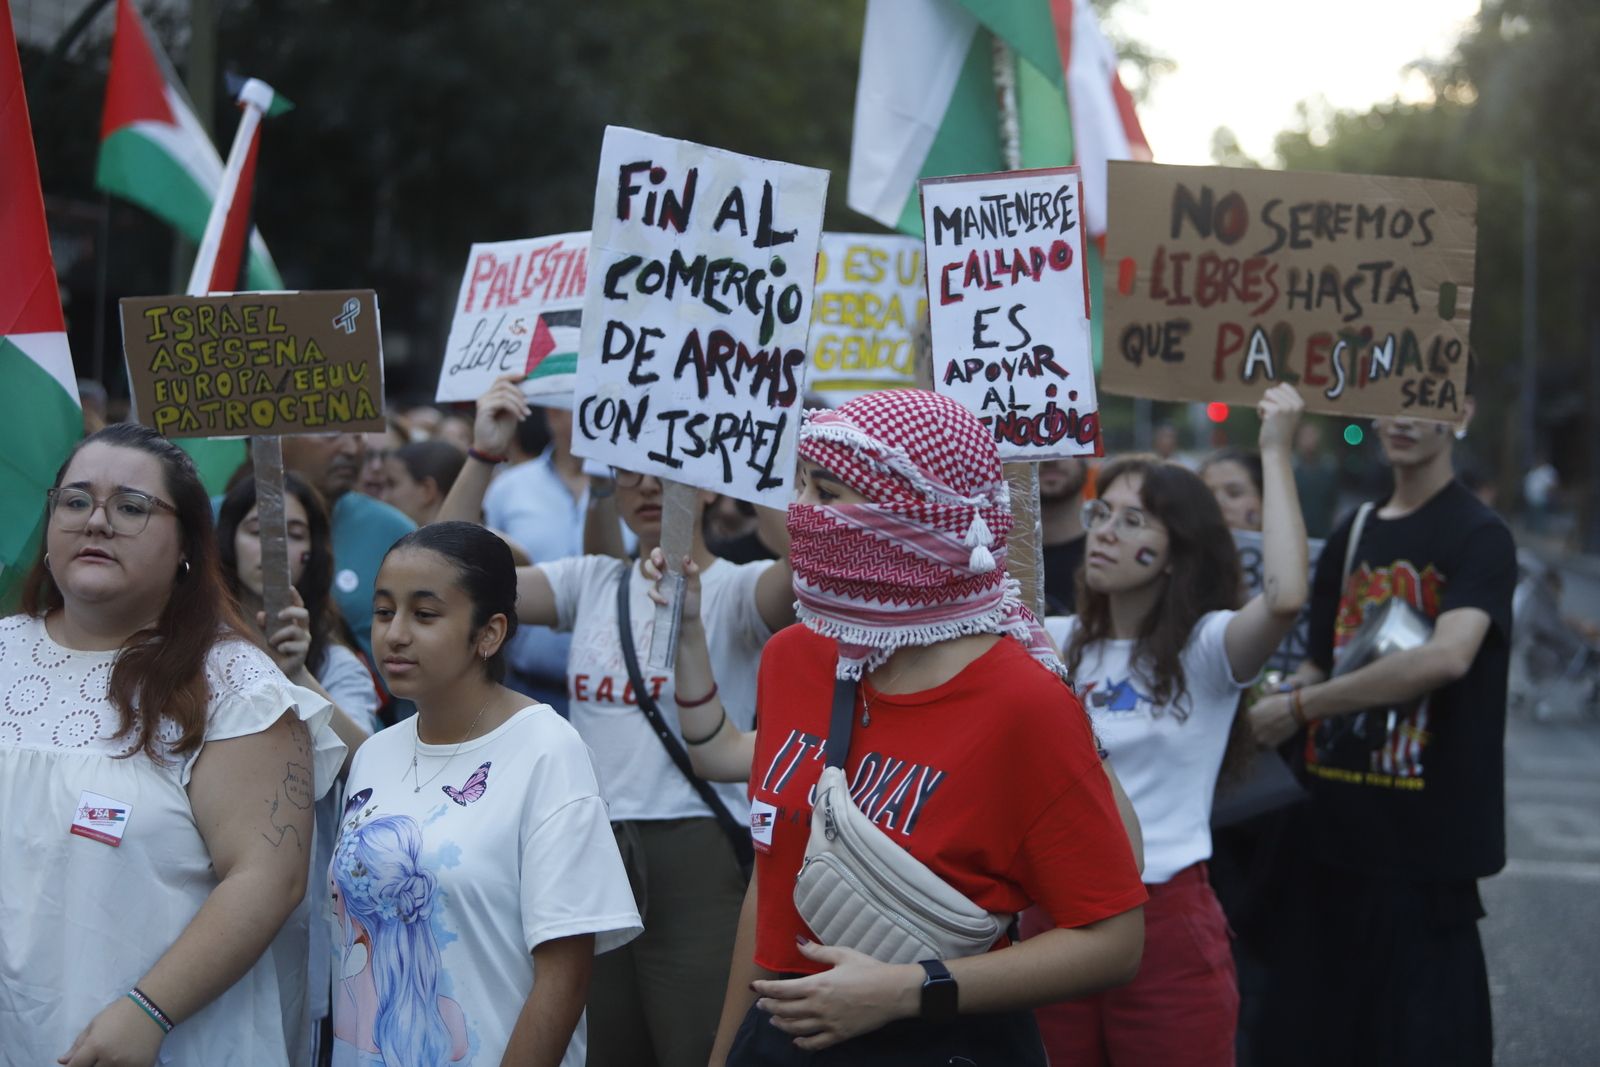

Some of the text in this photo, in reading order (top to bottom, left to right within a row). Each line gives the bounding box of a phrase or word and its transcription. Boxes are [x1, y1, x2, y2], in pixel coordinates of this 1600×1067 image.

[713, 179, 798, 248] AL
[933, 184, 1076, 246] MANTENERSE
[1170, 183, 1435, 256] NO SEREMOS
[940, 239, 1073, 306] CALLADO
[1149, 244, 1420, 323] LIBRES HASTA
[143, 304, 287, 343] ISRAEL
[972, 303, 1032, 351] ES
[1120, 319, 1192, 367] QUE
[1429, 337, 1462, 374] LO
[149, 334, 326, 376] ASESINA
[601, 320, 804, 408] DE ARMAS
[943, 344, 1070, 386] APOYAR
[152, 387, 378, 435] PATROCINA
[980, 385, 1031, 413] AL
[1402, 379, 1457, 412] SEA
[579, 395, 787, 491] CON ISRAEL
[849, 752, 948, 836] OKAY
